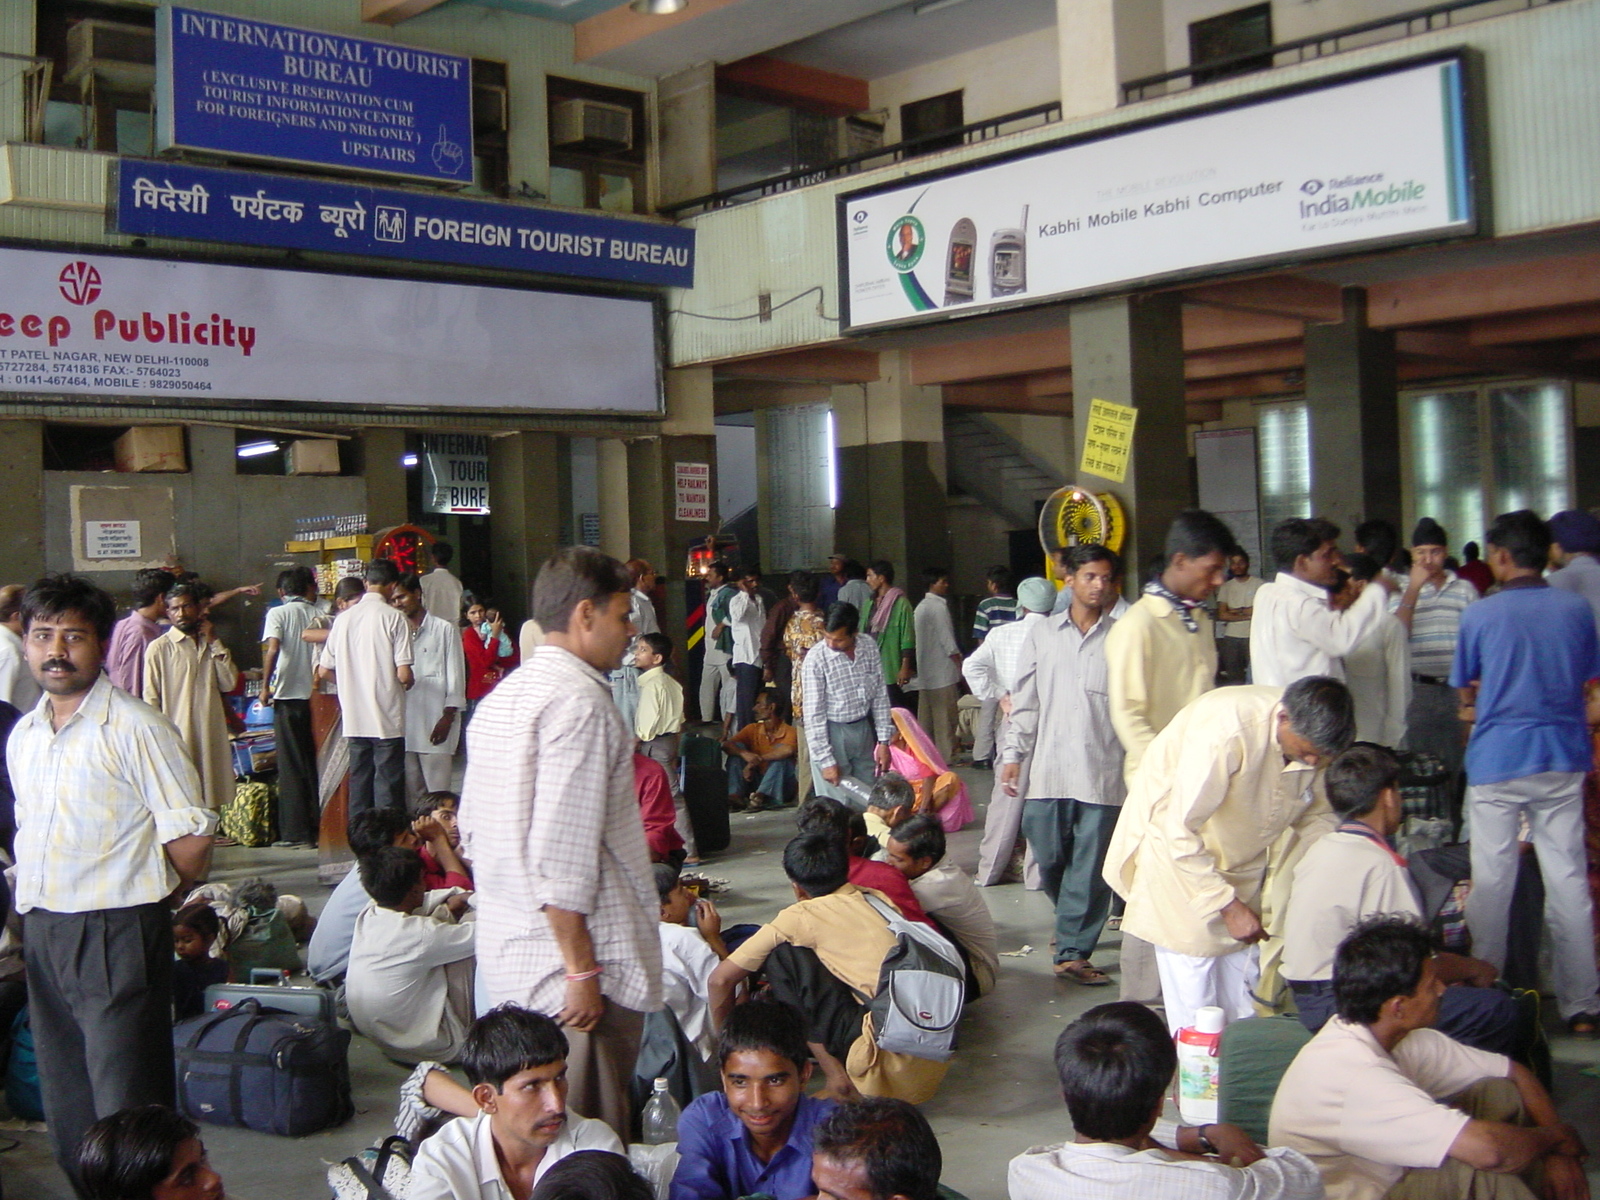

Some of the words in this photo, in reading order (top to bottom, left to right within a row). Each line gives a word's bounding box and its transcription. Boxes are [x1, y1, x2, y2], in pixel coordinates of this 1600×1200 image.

[180, 13, 369, 64] INTERNATIONAL
[372, 46, 462, 80] TOURIST
[211, 71, 289, 94] EXCLUSIVE
[292, 82, 383, 108] RESERVATION
[384, 99, 414, 113] CUM
[283, 55, 373, 88] BUREAU
[196, 100, 225, 115] FOR
[229, 104, 316, 128] FOREIGNERS
[319, 118, 346, 132] AND
[349, 123, 377, 138] NRIs
[380, 126, 414, 142] ONLY
[203, 85, 264, 105] TOURIST
[267, 95, 361, 119] INFORMATION
[363, 109, 415, 127] CENTRE
[342, 140, 416, 163] UPSTAIRS
[1300, 179, 1426, 219] IndiaMobile
[1329, 172, 1385, 191] Reliance
[132, 177, 210, 215] विदेशी
[230, 189, 304, 223] पर्यटक
[318, 200, 367, 238] ब्यूरो
[1039, 218, 1081, 238] Kabhi
[1088, 207, 1138, 229] Mobile
[1144, 196, 1190, 217] Kabhi
[1198, 180, 1284, 206] Computer
[414, 216, 511, 247] FOREIGN
[517, 228, 605, 258] TOURIST
[609, 239, 688, 267] BUREAU
[94, 309, 256, 356] Publicity
[11, 350, 50, 360] PATEL
[53, 352, 101, 363] NAGAR,
[104, 354, 132, 364] NEW
[135, 355, 209, 367] DELHI-110008
[52, 364, 100, 375] 5741836
[137, 367, 181, 378] 5764023
[15, 375, 91, 388] 0141-467464,
[94, 378, 140, 388] MOBILE
[150, 379, 212, 391] 9829050464
[451, 487, 486, 507] BURE
